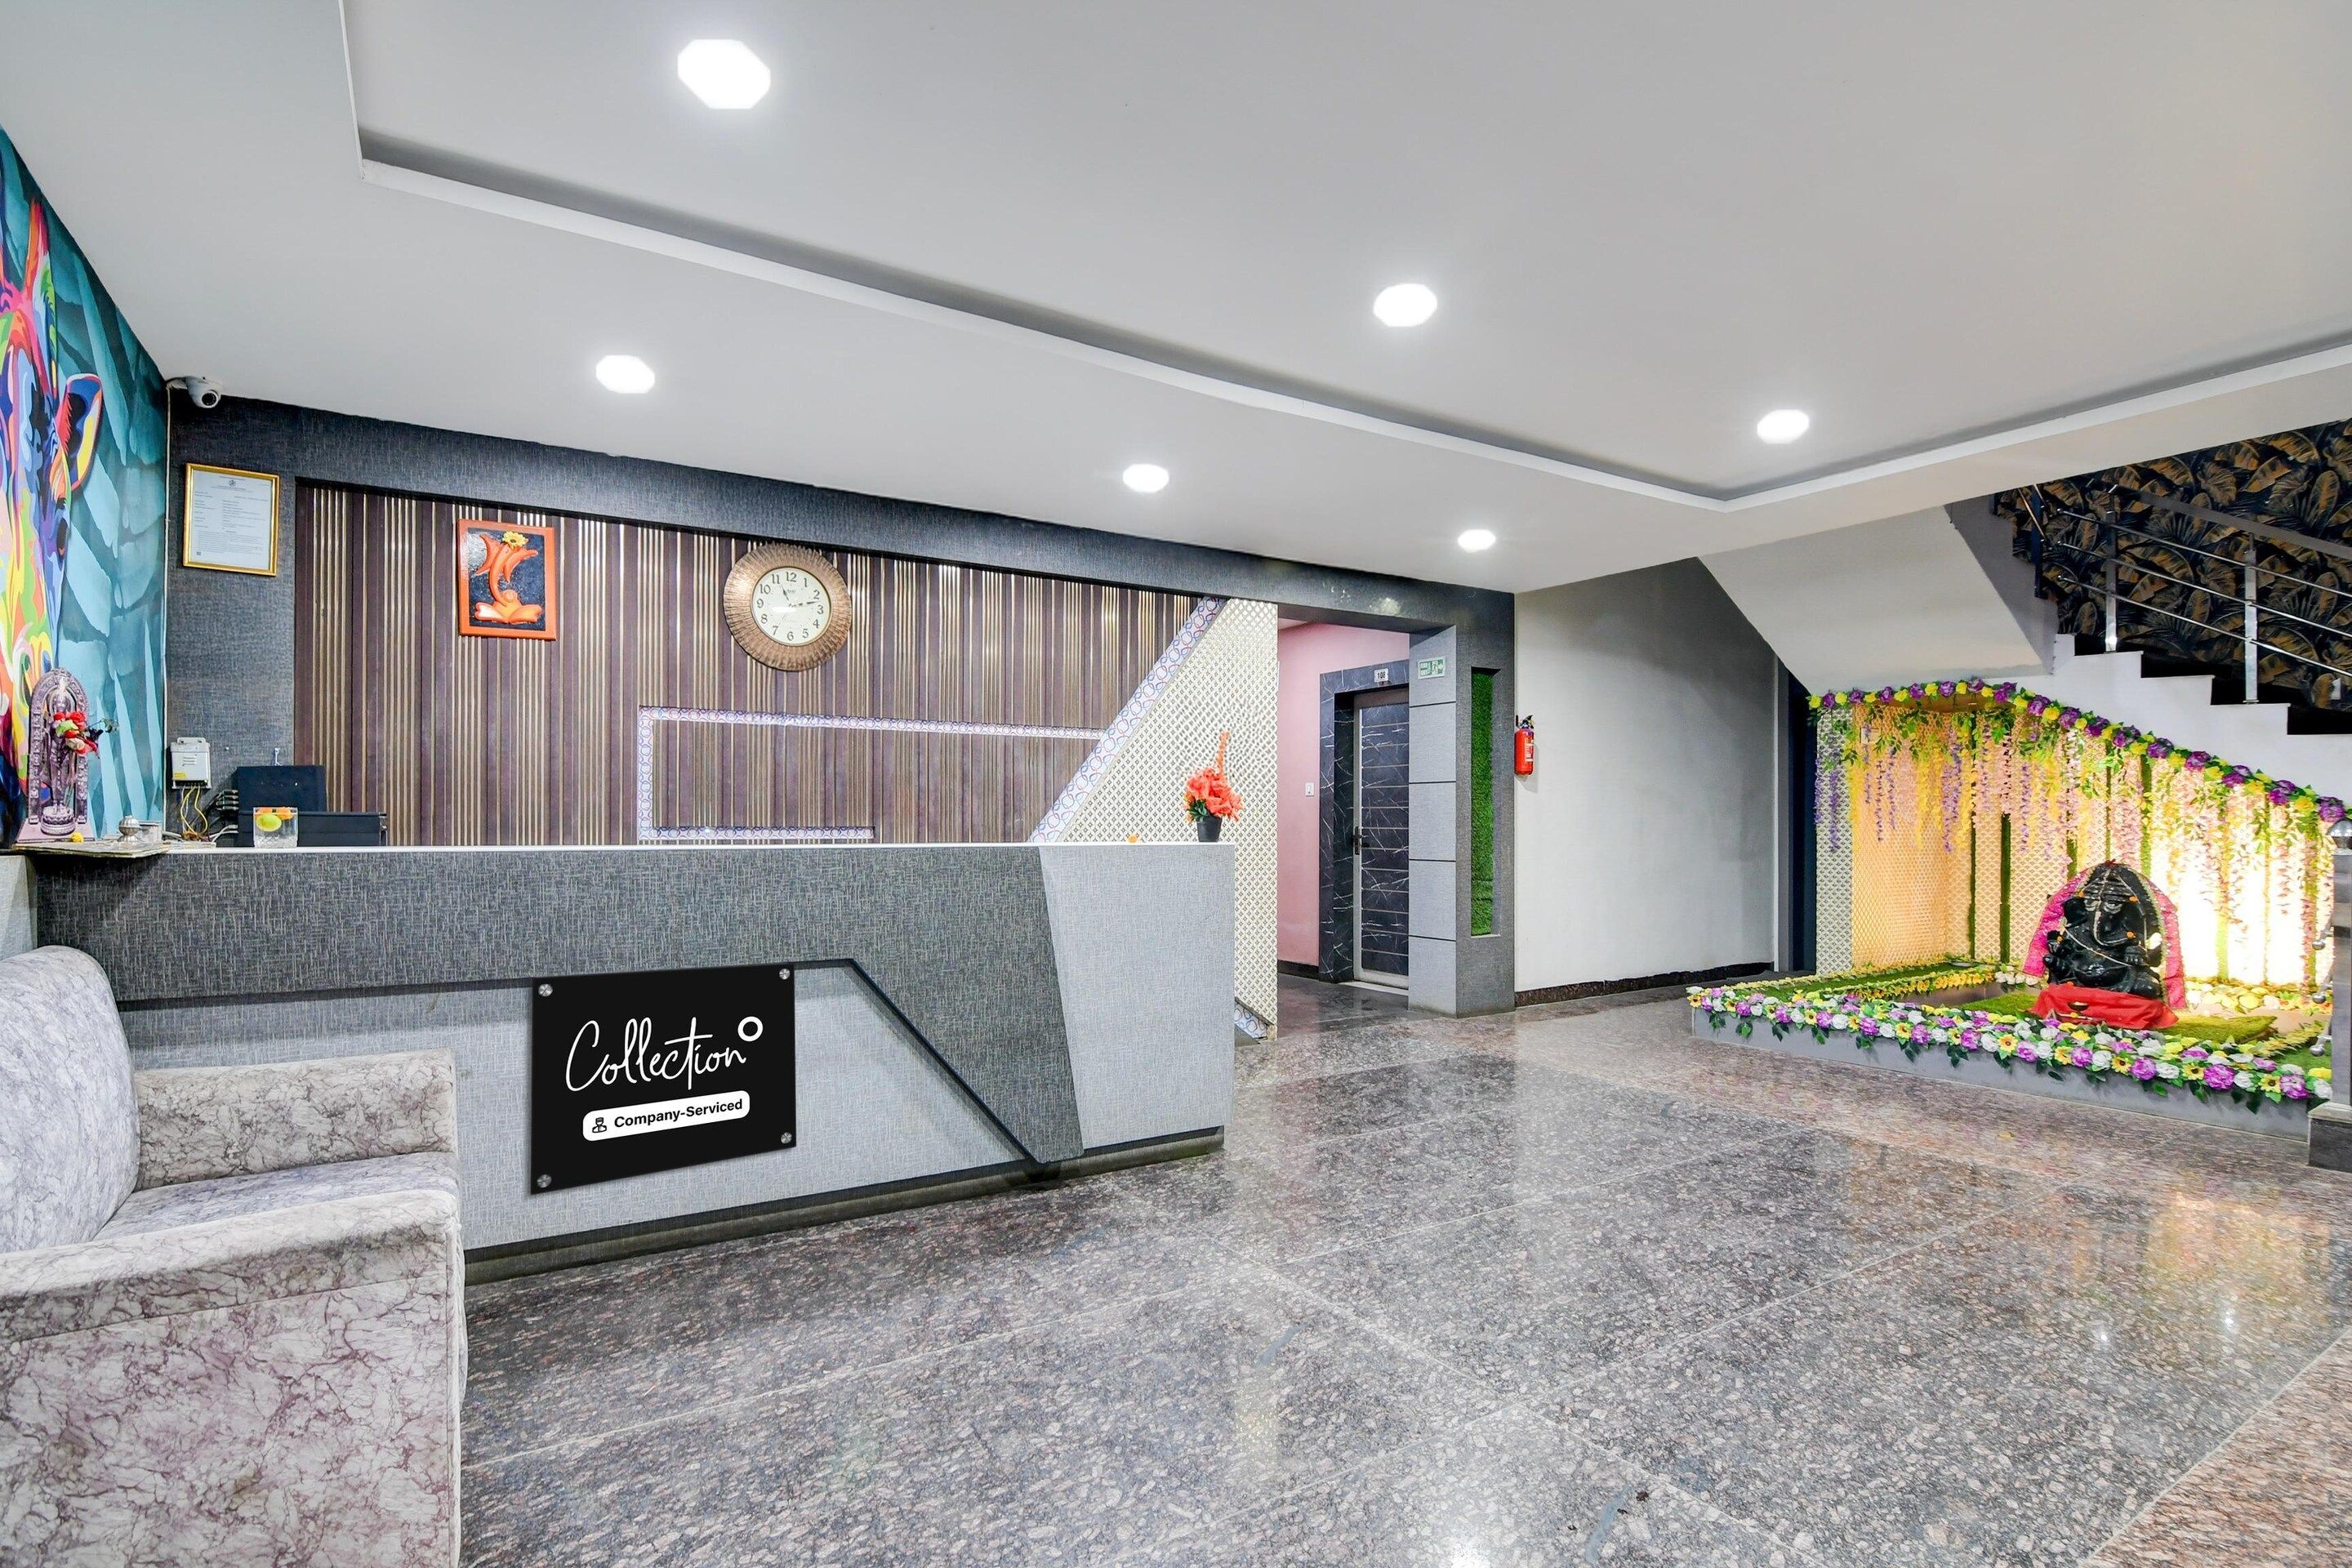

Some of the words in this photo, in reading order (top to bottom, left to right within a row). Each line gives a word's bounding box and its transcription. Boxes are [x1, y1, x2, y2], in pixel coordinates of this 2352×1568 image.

[772, 573, 780, 584] 11
[786, 571, 797, 582] 12
[760, 584, 771, 595] 10
[813, 590, 820, 599] 2
[756, 598, 764, 608] 9
[817, 604, 824, 614] 3
[760, 613, 768, 624] 8
[813, 619, 820, 628] 4
[772, 626, 778, 635] 7
[802, 628, 809, 638] 5
[786, 631, 794, 641] 6
[565, 1017, 746, 1092] Collection
[614, 1098, 743, 1128] Company-Serviced
